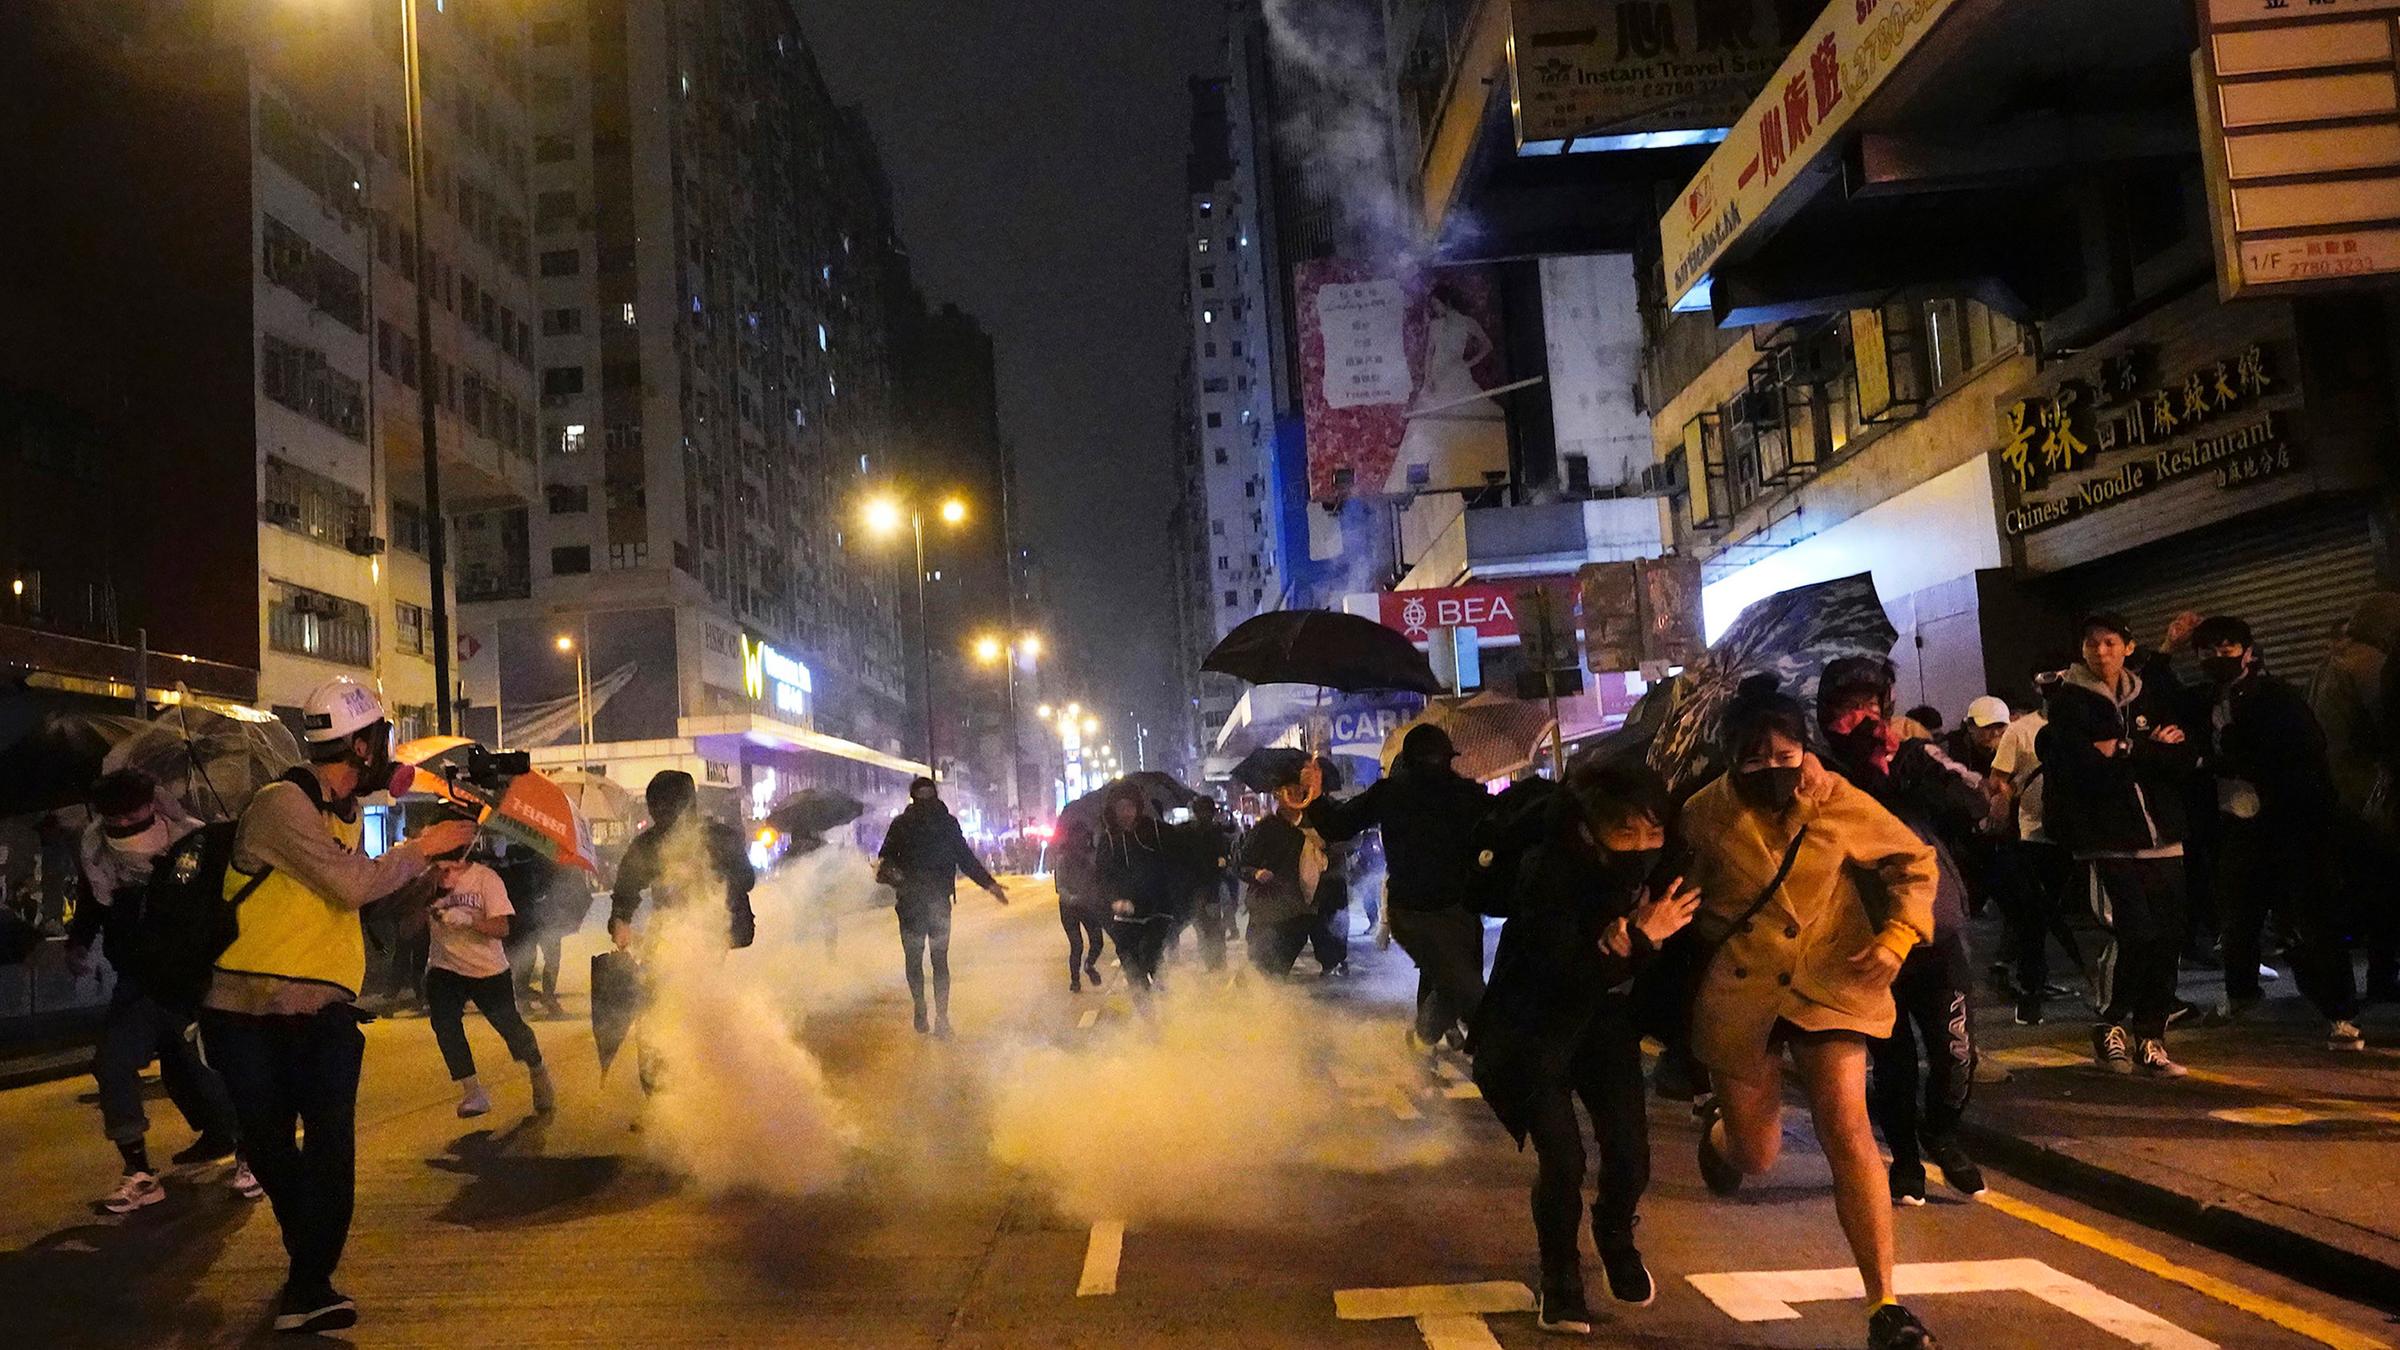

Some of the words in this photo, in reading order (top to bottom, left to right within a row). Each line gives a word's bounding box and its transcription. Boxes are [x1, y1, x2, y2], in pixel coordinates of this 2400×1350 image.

[1577, 64, 1653, 85] Instant
[1659, 58, 1724, 78] Travel
[2250, 252, 2282, 271] 1/F
[2096, 344, 2271, 451] 四川麻辣米線
[2004, 497, 2070, 536] Chinese
[2077, 462, 2144, 510] Noodle
[2155, 413, 2275, 482] Restaurant
[1437, 595, 1514, 626] BEA
